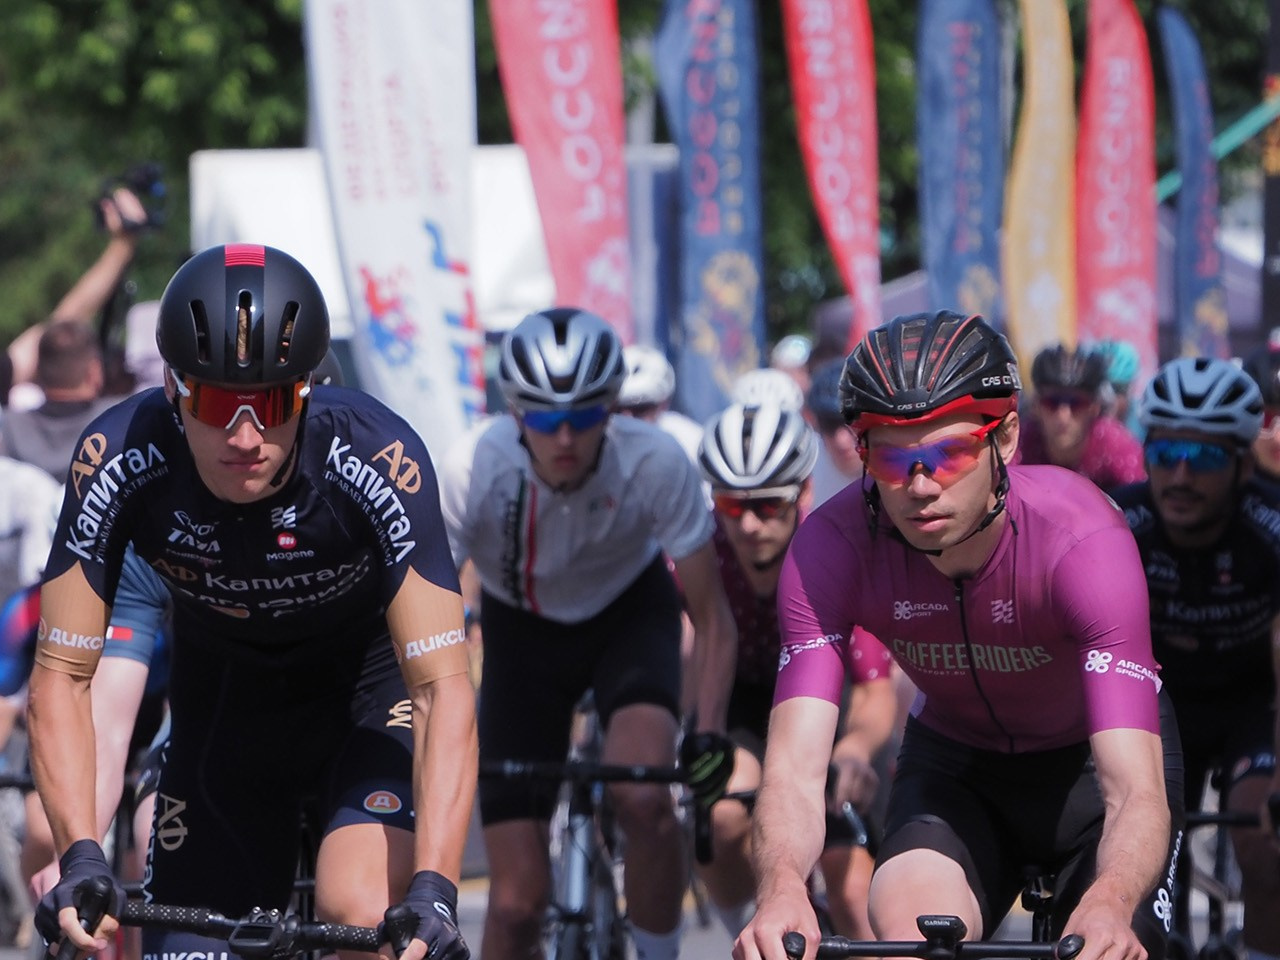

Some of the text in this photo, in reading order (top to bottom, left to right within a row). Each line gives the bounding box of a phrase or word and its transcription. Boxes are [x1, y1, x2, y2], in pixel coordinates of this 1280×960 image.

[71, 432, 107, 499] АФ
[371, 439, 422, 494] АФ
[65, 442, 166, 561] Капитал
[326, 436, 416, 563] Капитал
[205, 563, 353, 592] Капитал
[266, 549, 315, 561] Magene
[1115, 667, 1146, 681] SPORT
